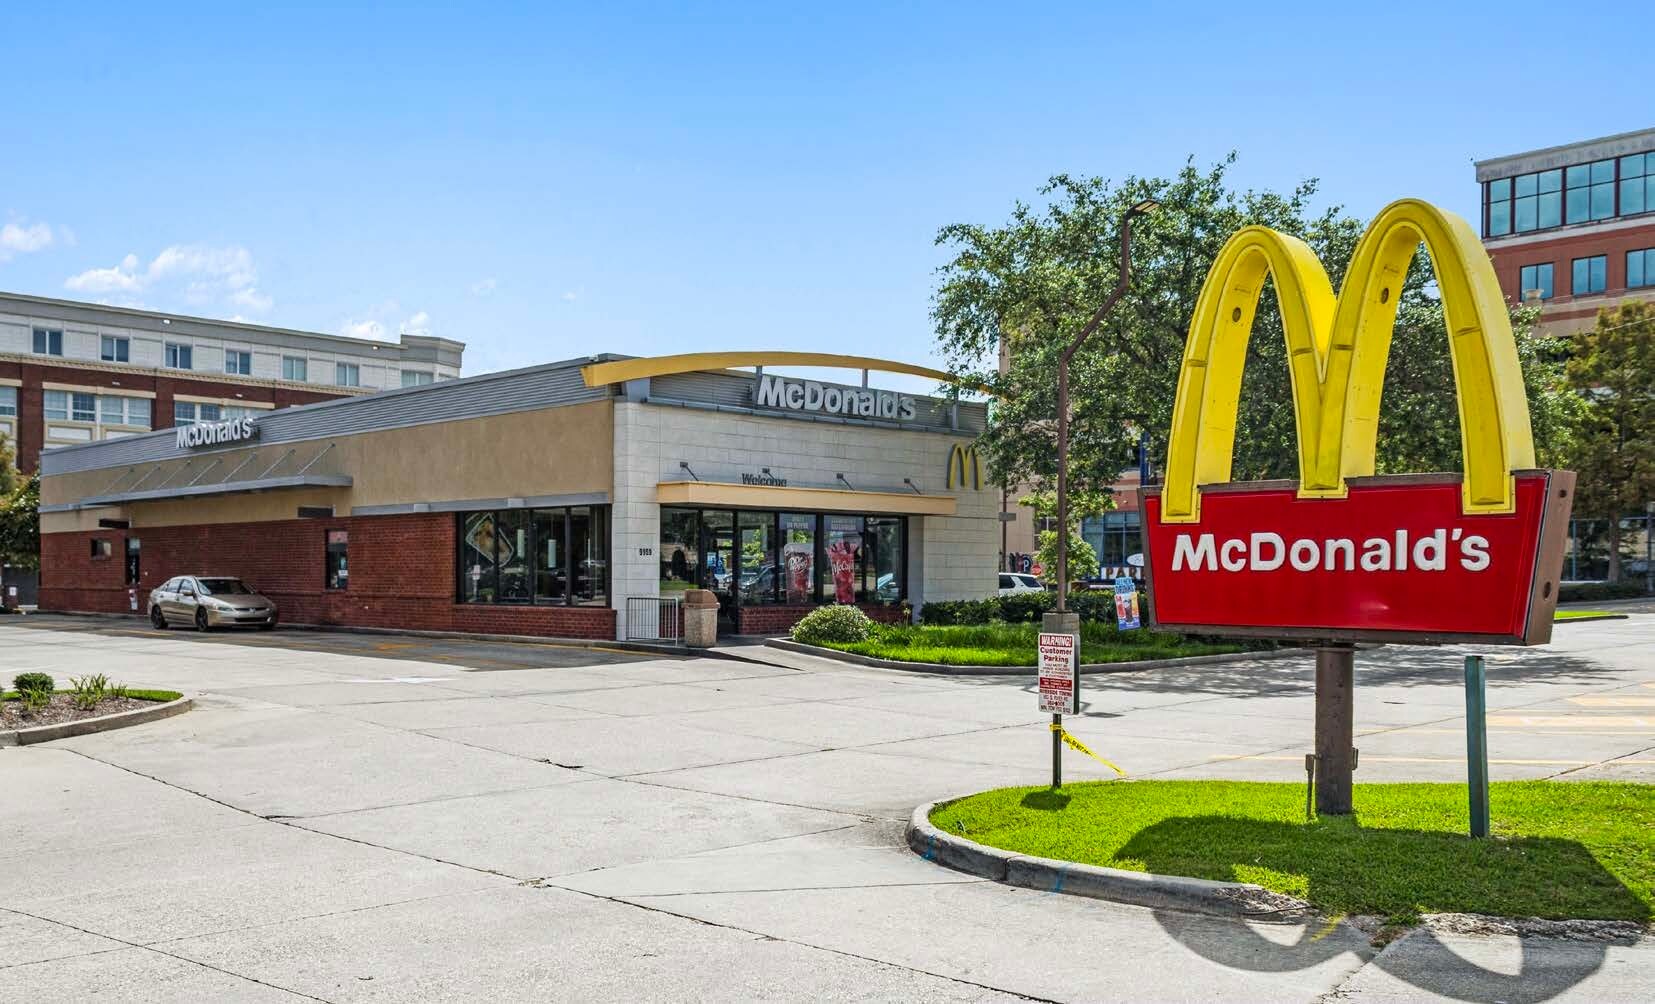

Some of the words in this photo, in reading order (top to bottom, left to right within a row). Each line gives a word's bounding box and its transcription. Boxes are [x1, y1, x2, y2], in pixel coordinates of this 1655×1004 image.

[176, 416, 254, 449] McDonald's
[741, 472, 787, 487] Welcome
[1171, 527, 1491, 572] McDonald's
[1041, 636, 1072, 646] WARNING!
[1040, 647, 1072, 655] Customer
[1044, 655, 1069, 664] Parking
